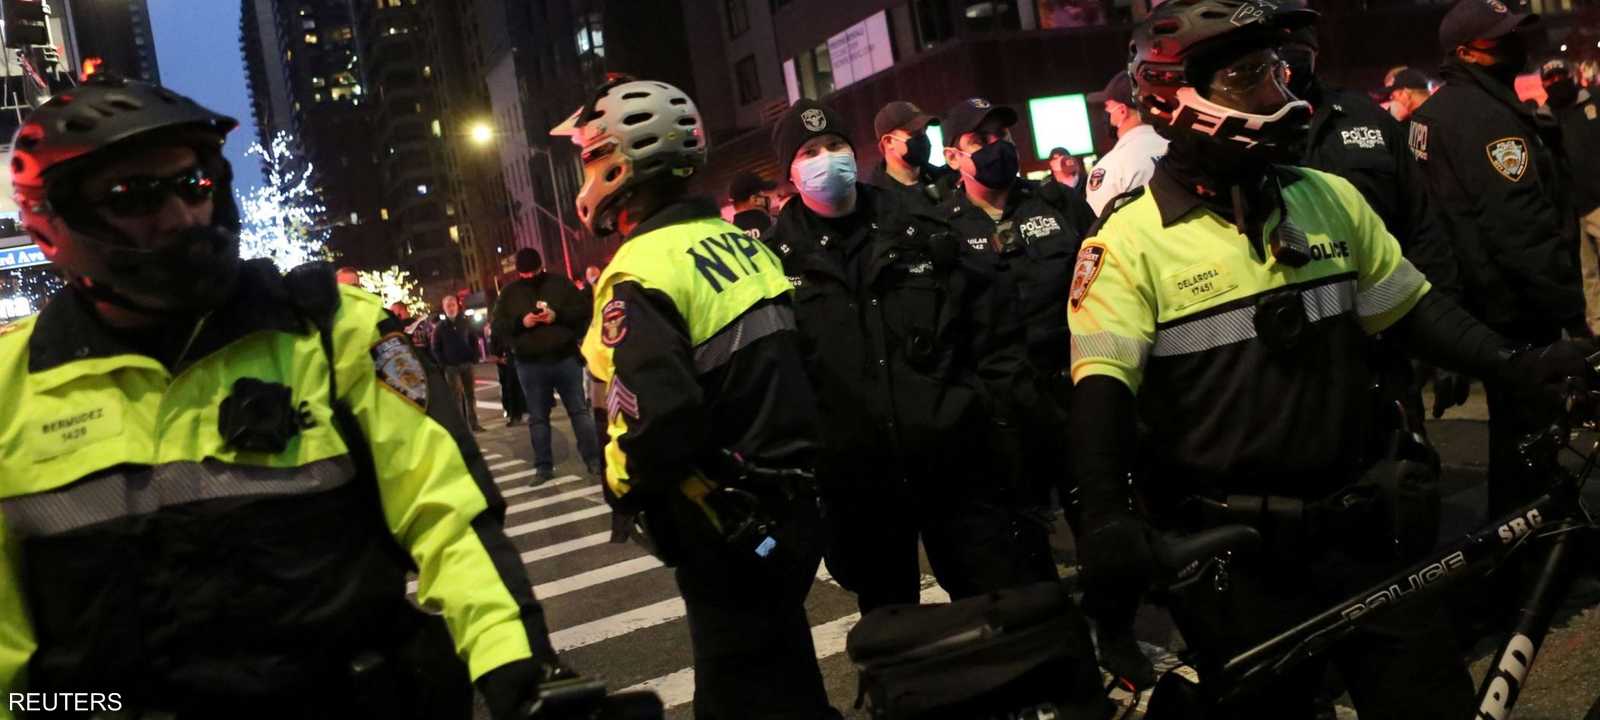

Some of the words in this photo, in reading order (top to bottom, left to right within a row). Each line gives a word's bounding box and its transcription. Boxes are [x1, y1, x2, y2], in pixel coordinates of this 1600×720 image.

[1341, 128, 1383, 142] POLICE
[1019, 217, 1057, 236] POLICE
[1310, 241, 1350, 260] OLICE
[686, 232, 779, 294] NYP
[1177, 269, 1219, 290] DELAROSA
[42, 408, 104, 434] BERMUDEZ
[1475, 633, 1534, 720] PD
